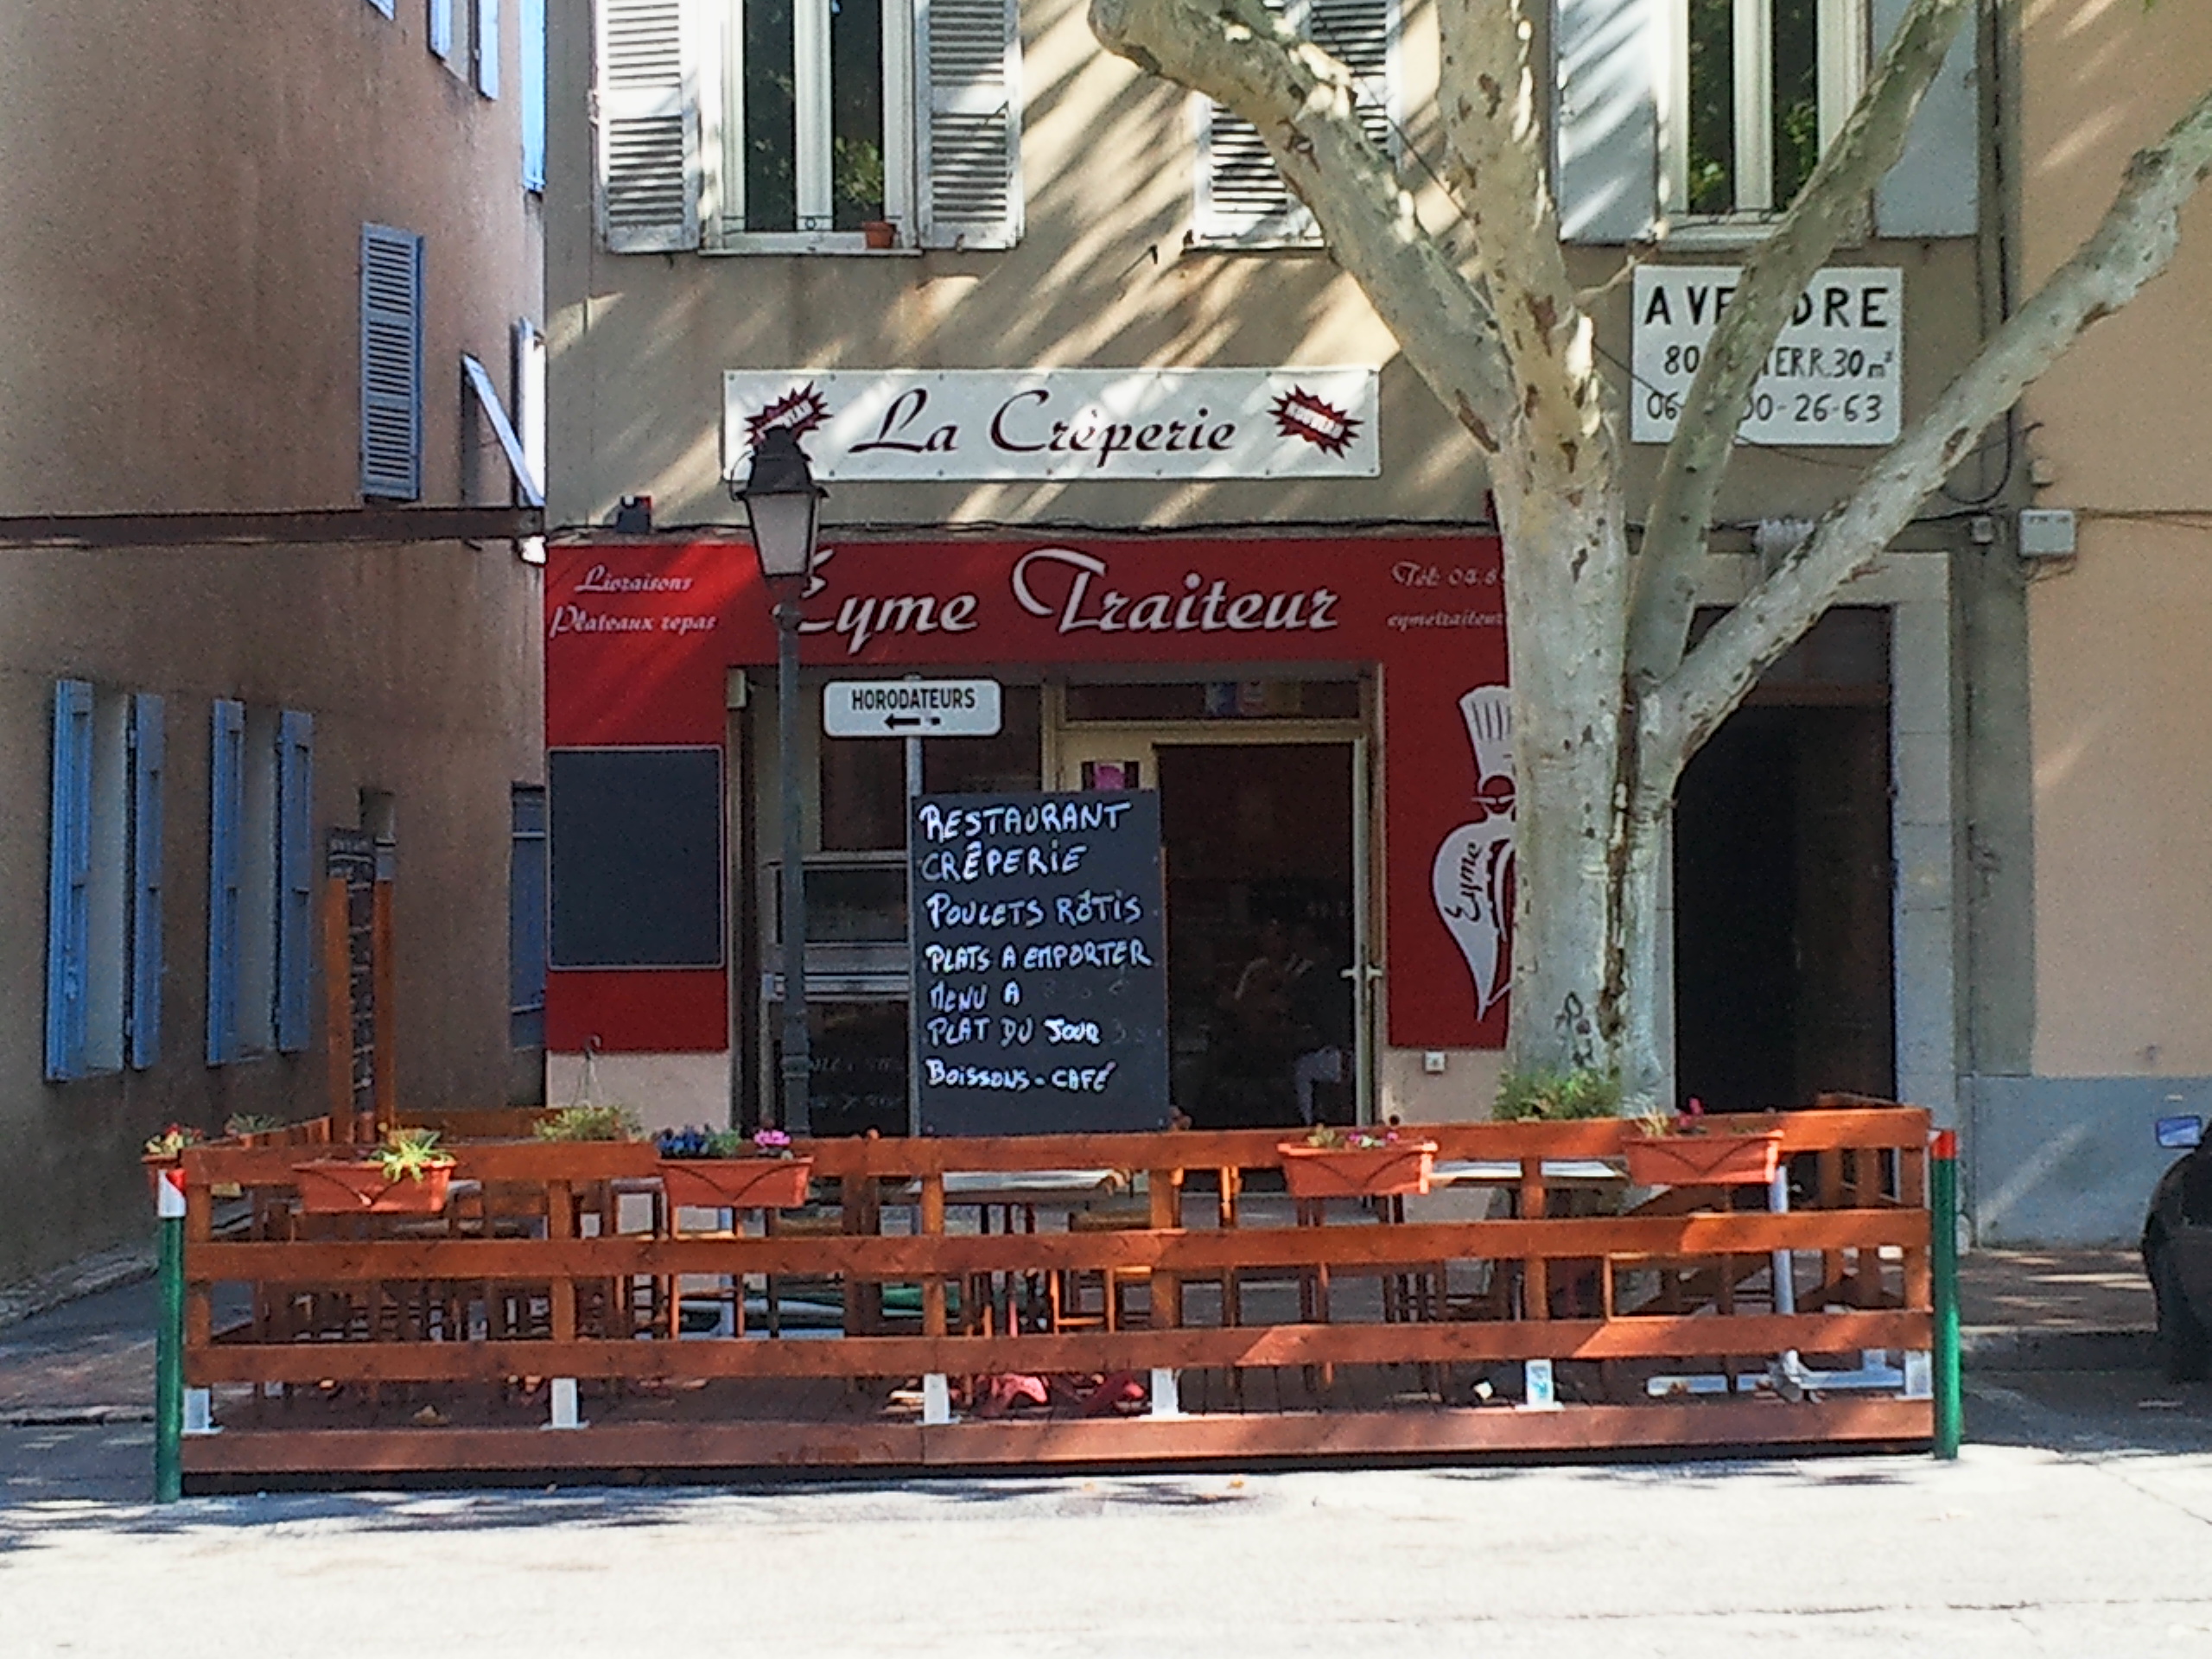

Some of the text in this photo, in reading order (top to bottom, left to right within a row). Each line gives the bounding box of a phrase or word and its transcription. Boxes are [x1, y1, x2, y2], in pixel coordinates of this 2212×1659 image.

[1644, 286, 1888, 327] A VEDRE
[848, 388, 957, 454] La
[574, 564, 693, 593] Livraisons
[1011, 549, 1338, 636] Traiteur
[548, 603, 717, 638] Plateaux repas
[851, 688, 976, 710] HORODATEURS
[918, 801, 1131, 843] RESTAURANT
[1445, 842, 1484, 924] Eyme
[925, 944, 991, 975] PLATS
[1003, 981, 1023, 1006] A
[926, 1016, 991, 1047] PLAT
[1044, 1019, 1101, 1045] JOUR
